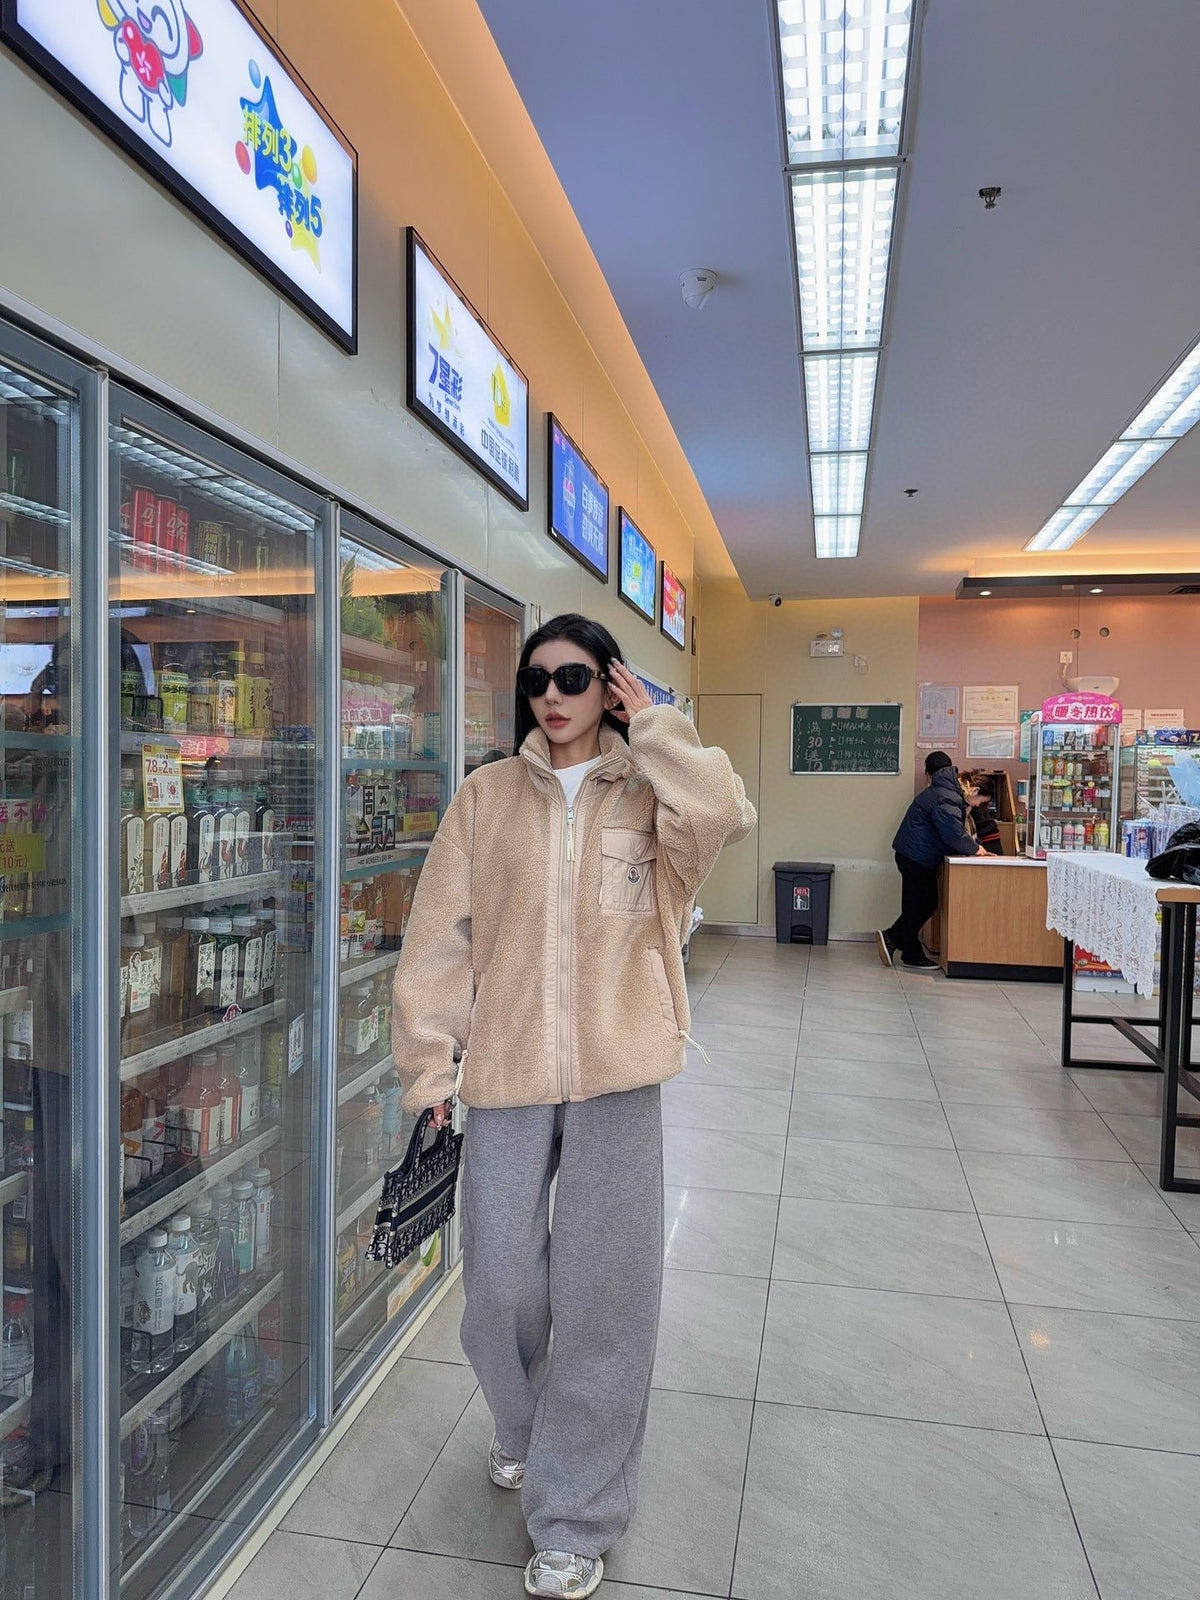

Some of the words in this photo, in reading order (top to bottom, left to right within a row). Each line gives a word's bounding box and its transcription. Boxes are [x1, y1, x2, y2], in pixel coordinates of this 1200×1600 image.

[244, 106, 293, 174] 排列3
[277, 182, 322, 238] 排列5
[428, 342, 463, 402] 7星彩
[1053, 704, 1115, 720] 暖冬热饮
[807, 736, 823, 749] 30
